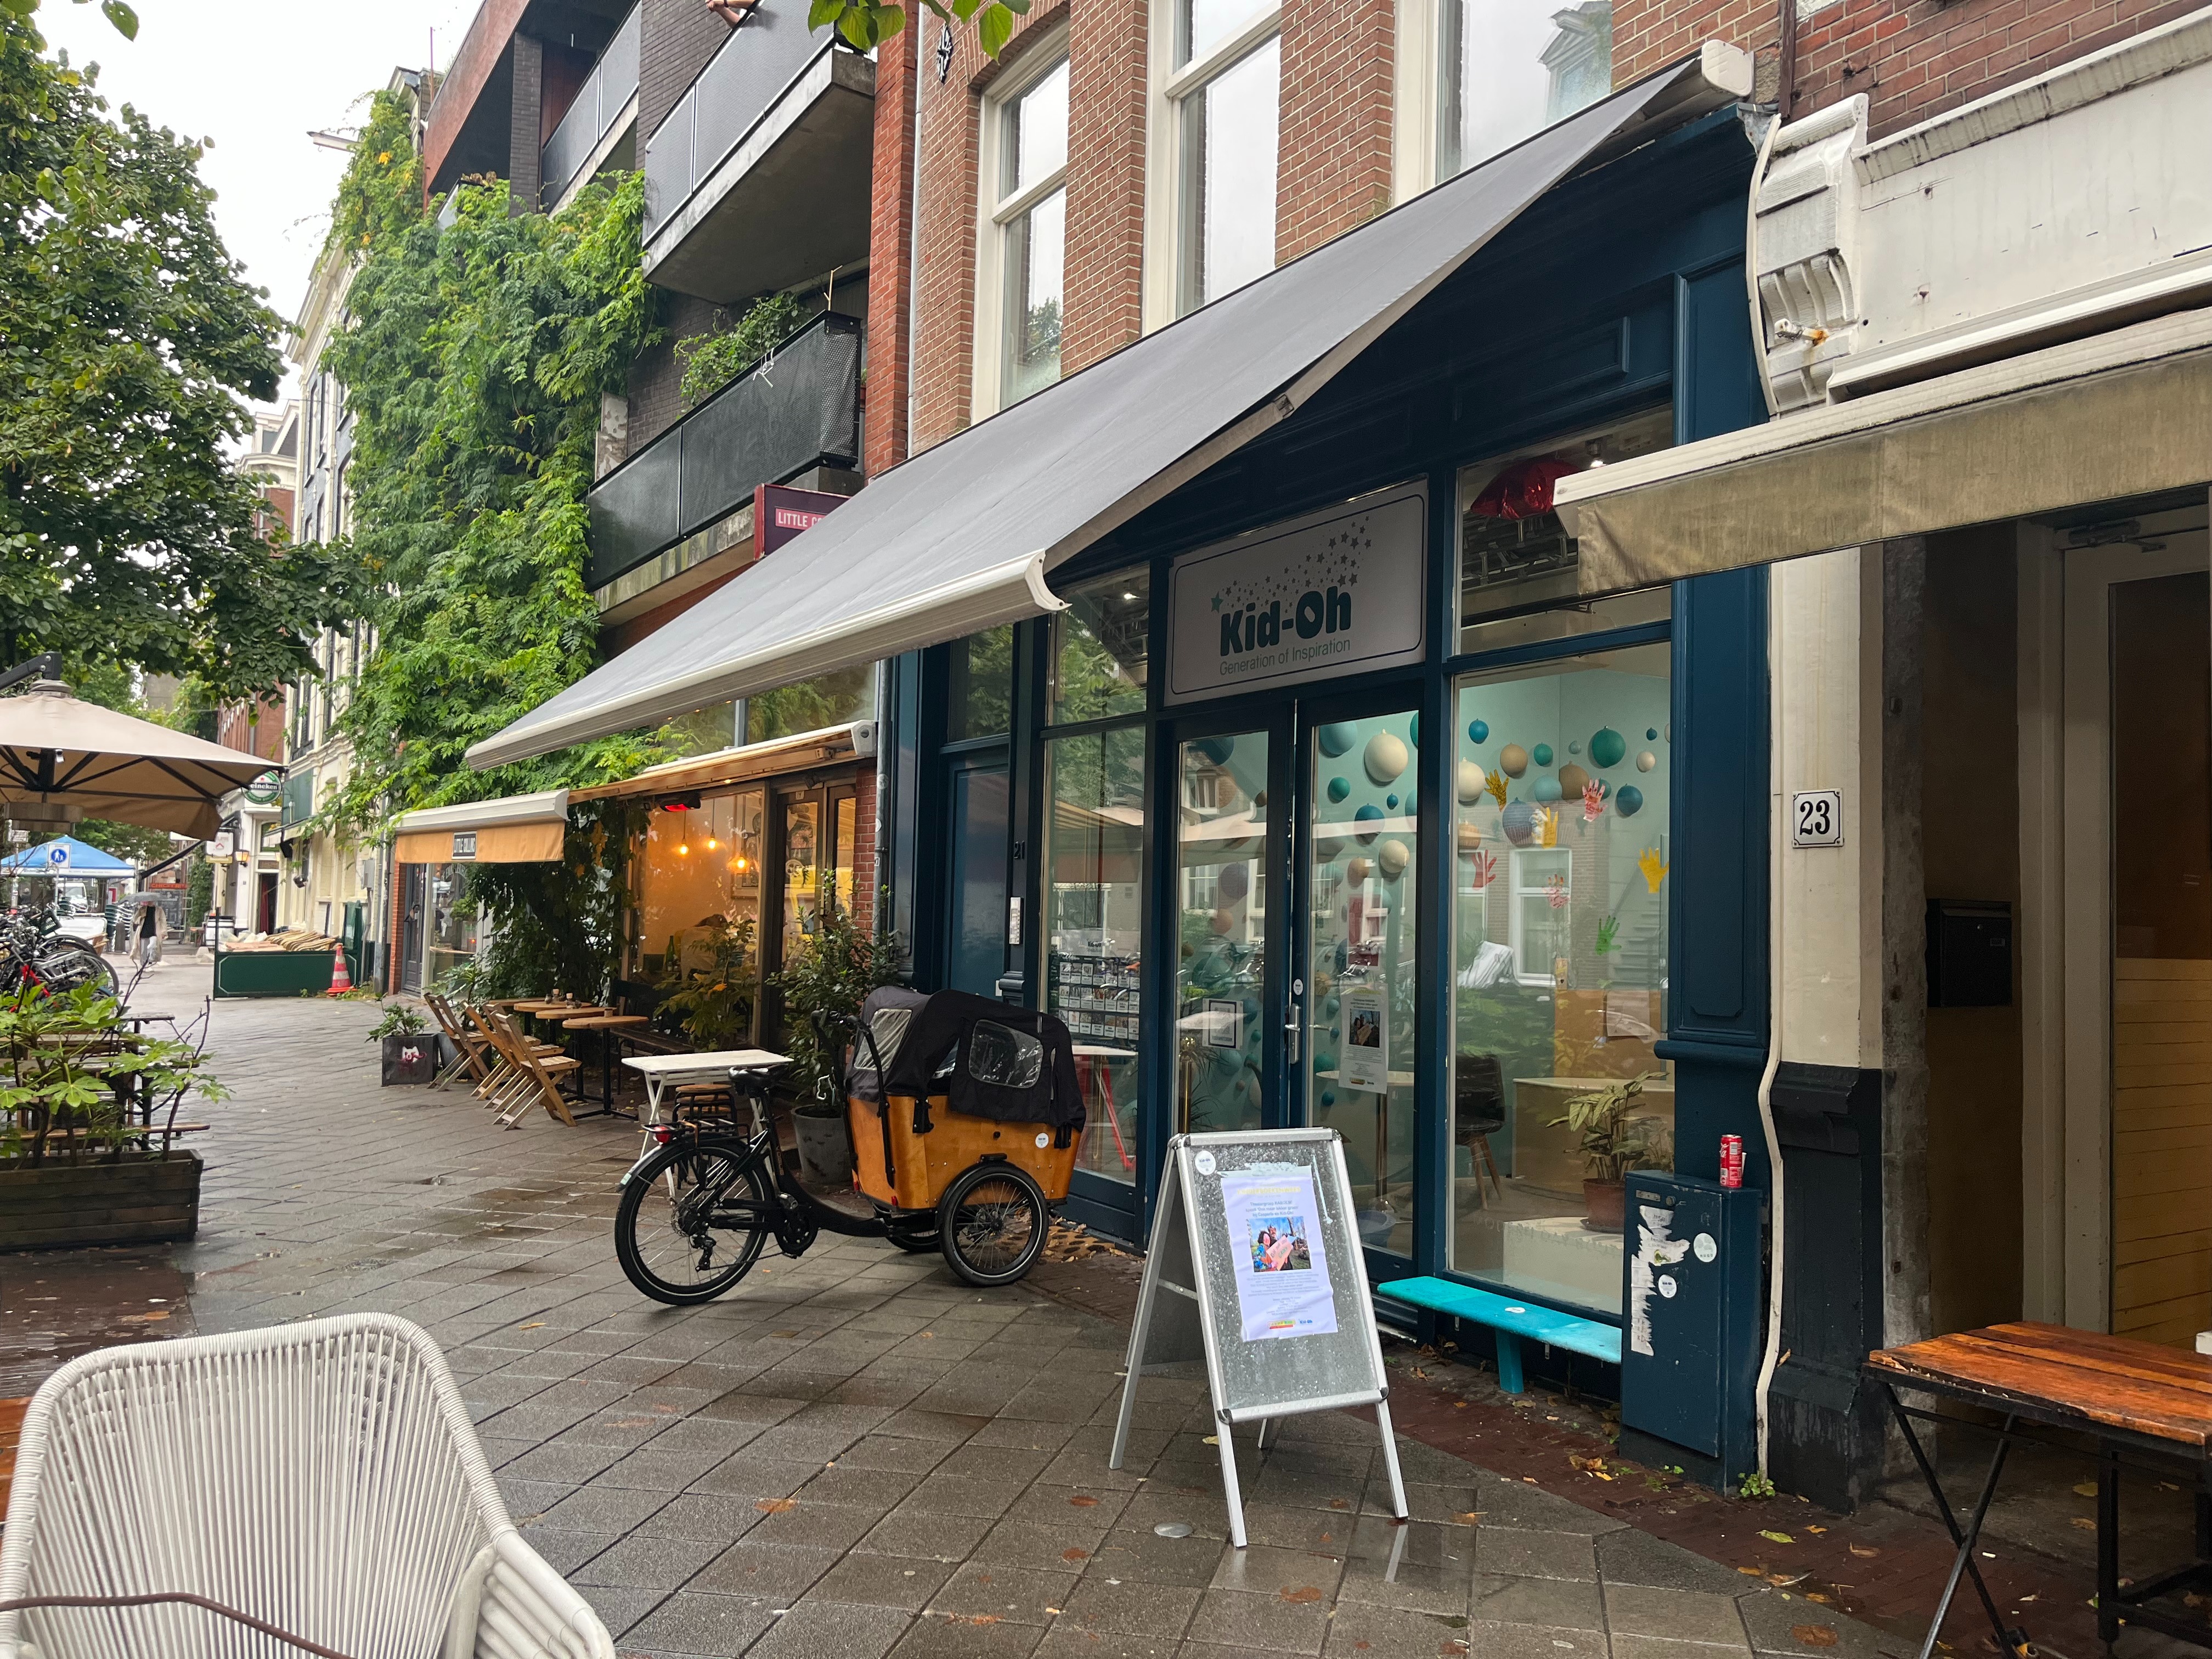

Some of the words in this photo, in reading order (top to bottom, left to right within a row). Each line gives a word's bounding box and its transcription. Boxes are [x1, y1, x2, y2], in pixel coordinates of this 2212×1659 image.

[778, 512, 808, 527] LITTLE
[1220, 586, 1352, 657] Kid-Oh
[1220, 654, 1275, 676] Generation
[1278, 648, 1291, 664] of
[1292, 638, 1351, 662] Inspiration
[1800, 799, 1830, 836] 23
[1014, 840, 1025, 860] 21
